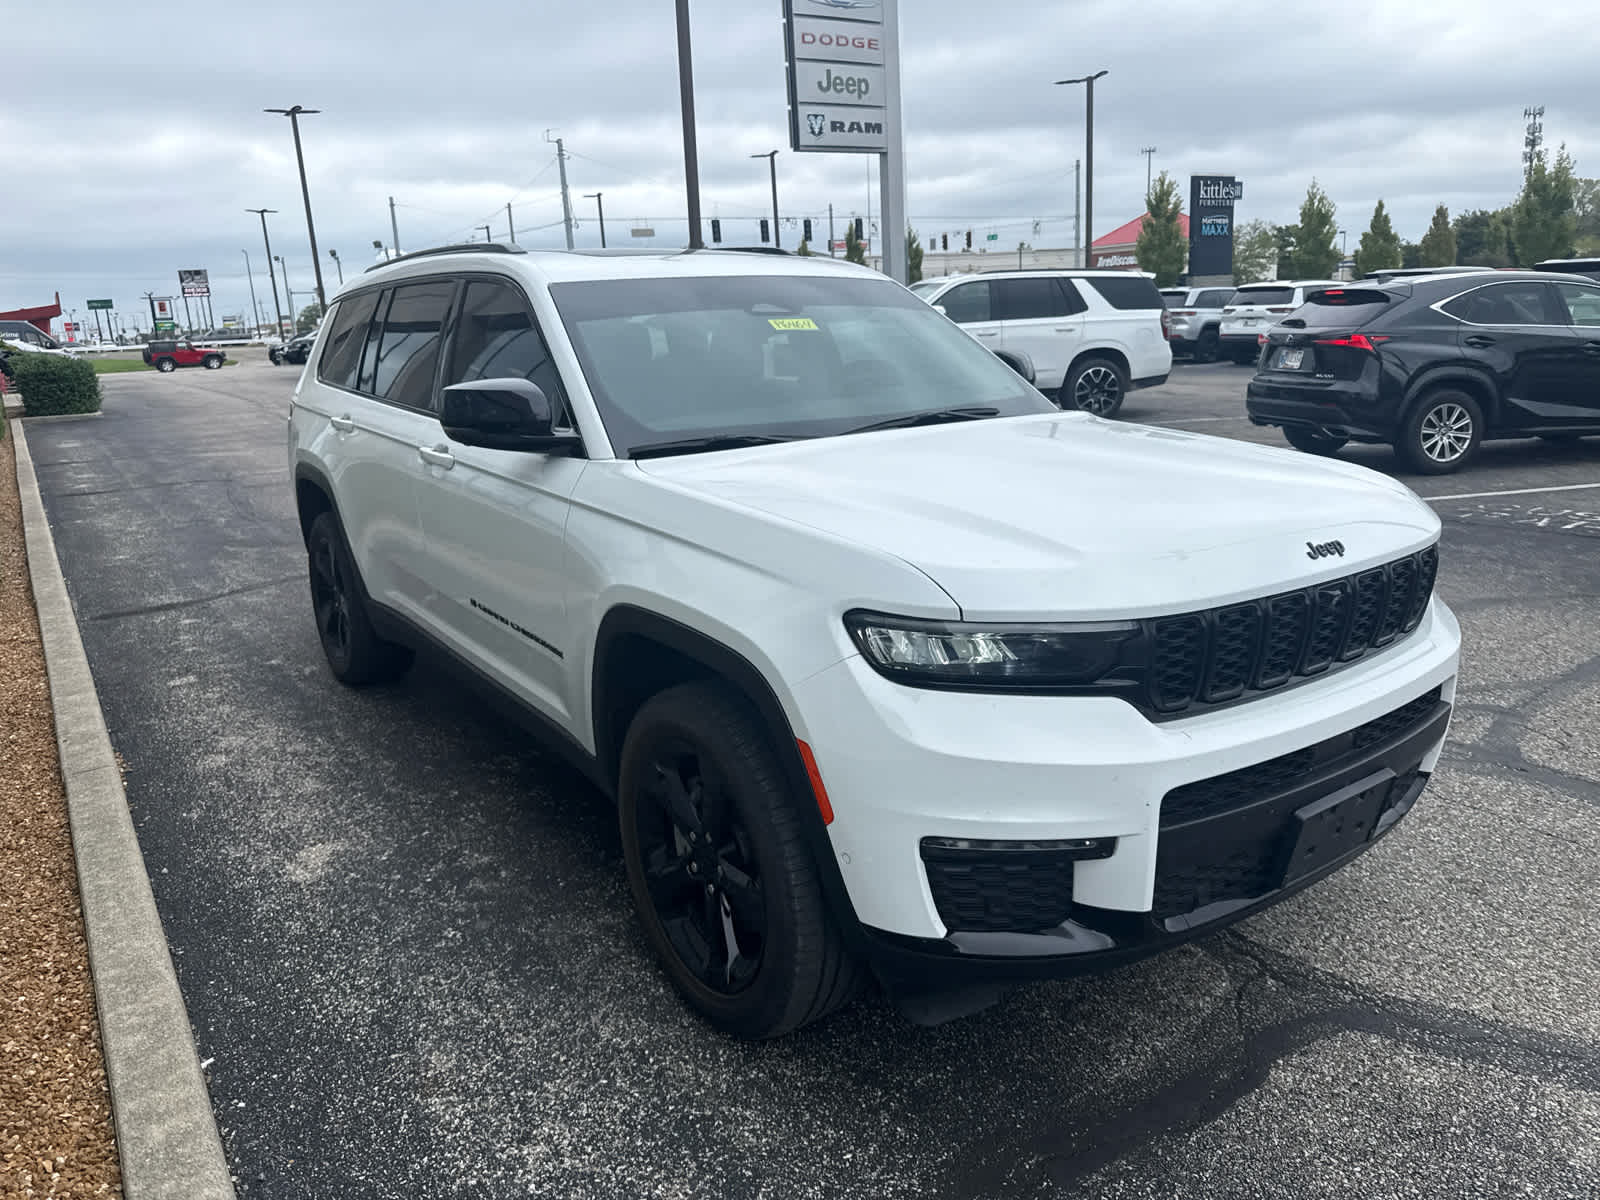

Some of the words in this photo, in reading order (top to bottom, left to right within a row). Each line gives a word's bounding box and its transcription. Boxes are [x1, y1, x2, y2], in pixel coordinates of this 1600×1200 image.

[801, 33, 880, 50] DODGE
[817, 69, 870, 99] Jeep
[830, 121, 882, 134] RAM
[1200, 180, 1235, 199] kittle's
[1201, 224, 1229, 235] MAXX
[1306, 540, 1345, 560] Jeep
